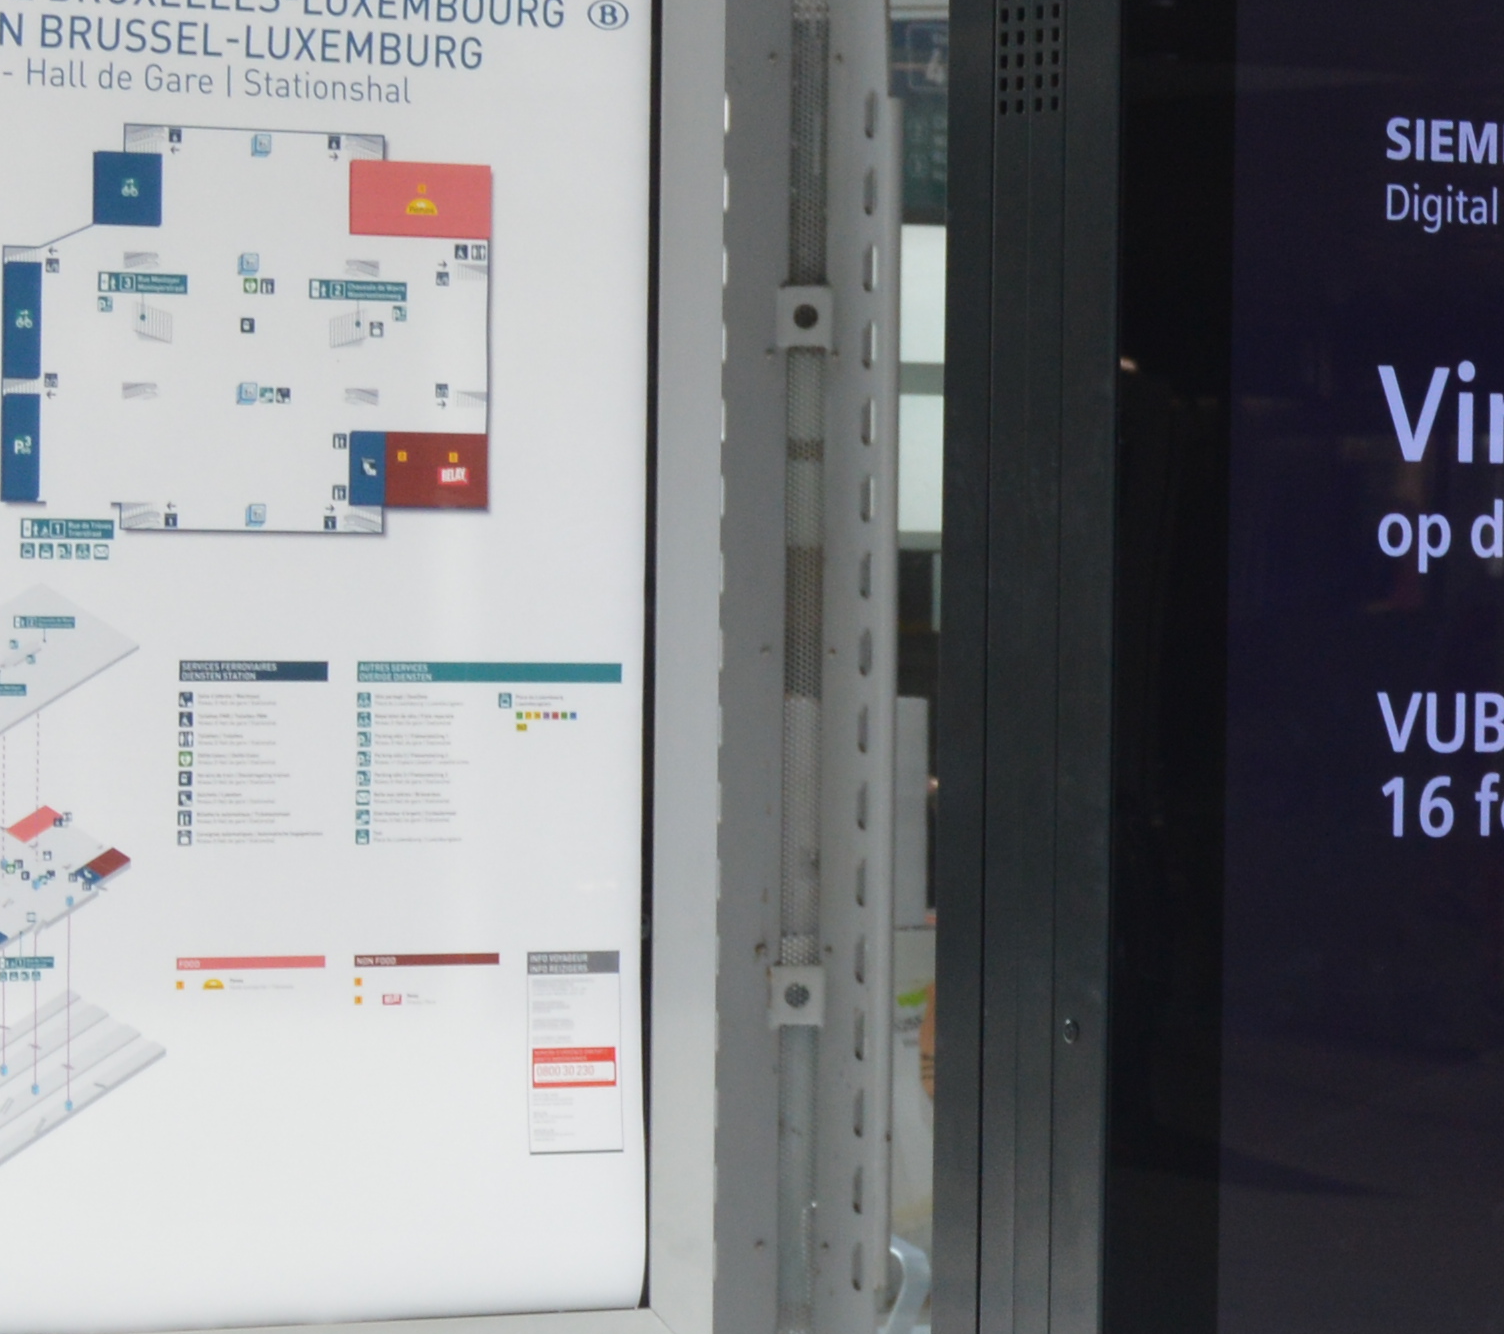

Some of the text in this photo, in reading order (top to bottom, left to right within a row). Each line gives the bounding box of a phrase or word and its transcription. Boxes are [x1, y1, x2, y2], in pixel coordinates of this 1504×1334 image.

[39, 13, 483, 70] BRUSSEL-LUXEMBURG
[27, 58, 86, 88] Hall
[98, 62, 132, 90] de
[144, 63, 213, 94] Gare
[244, 68, 410, 103] Stationshal
[1386, 183, 1498, 233] Digital
[124, 277, 131, 288] 3
[334, 284, 341, 296] 2
[1378, 513, 1451, 573] op
[1382, 776, 1454, 837] 16
